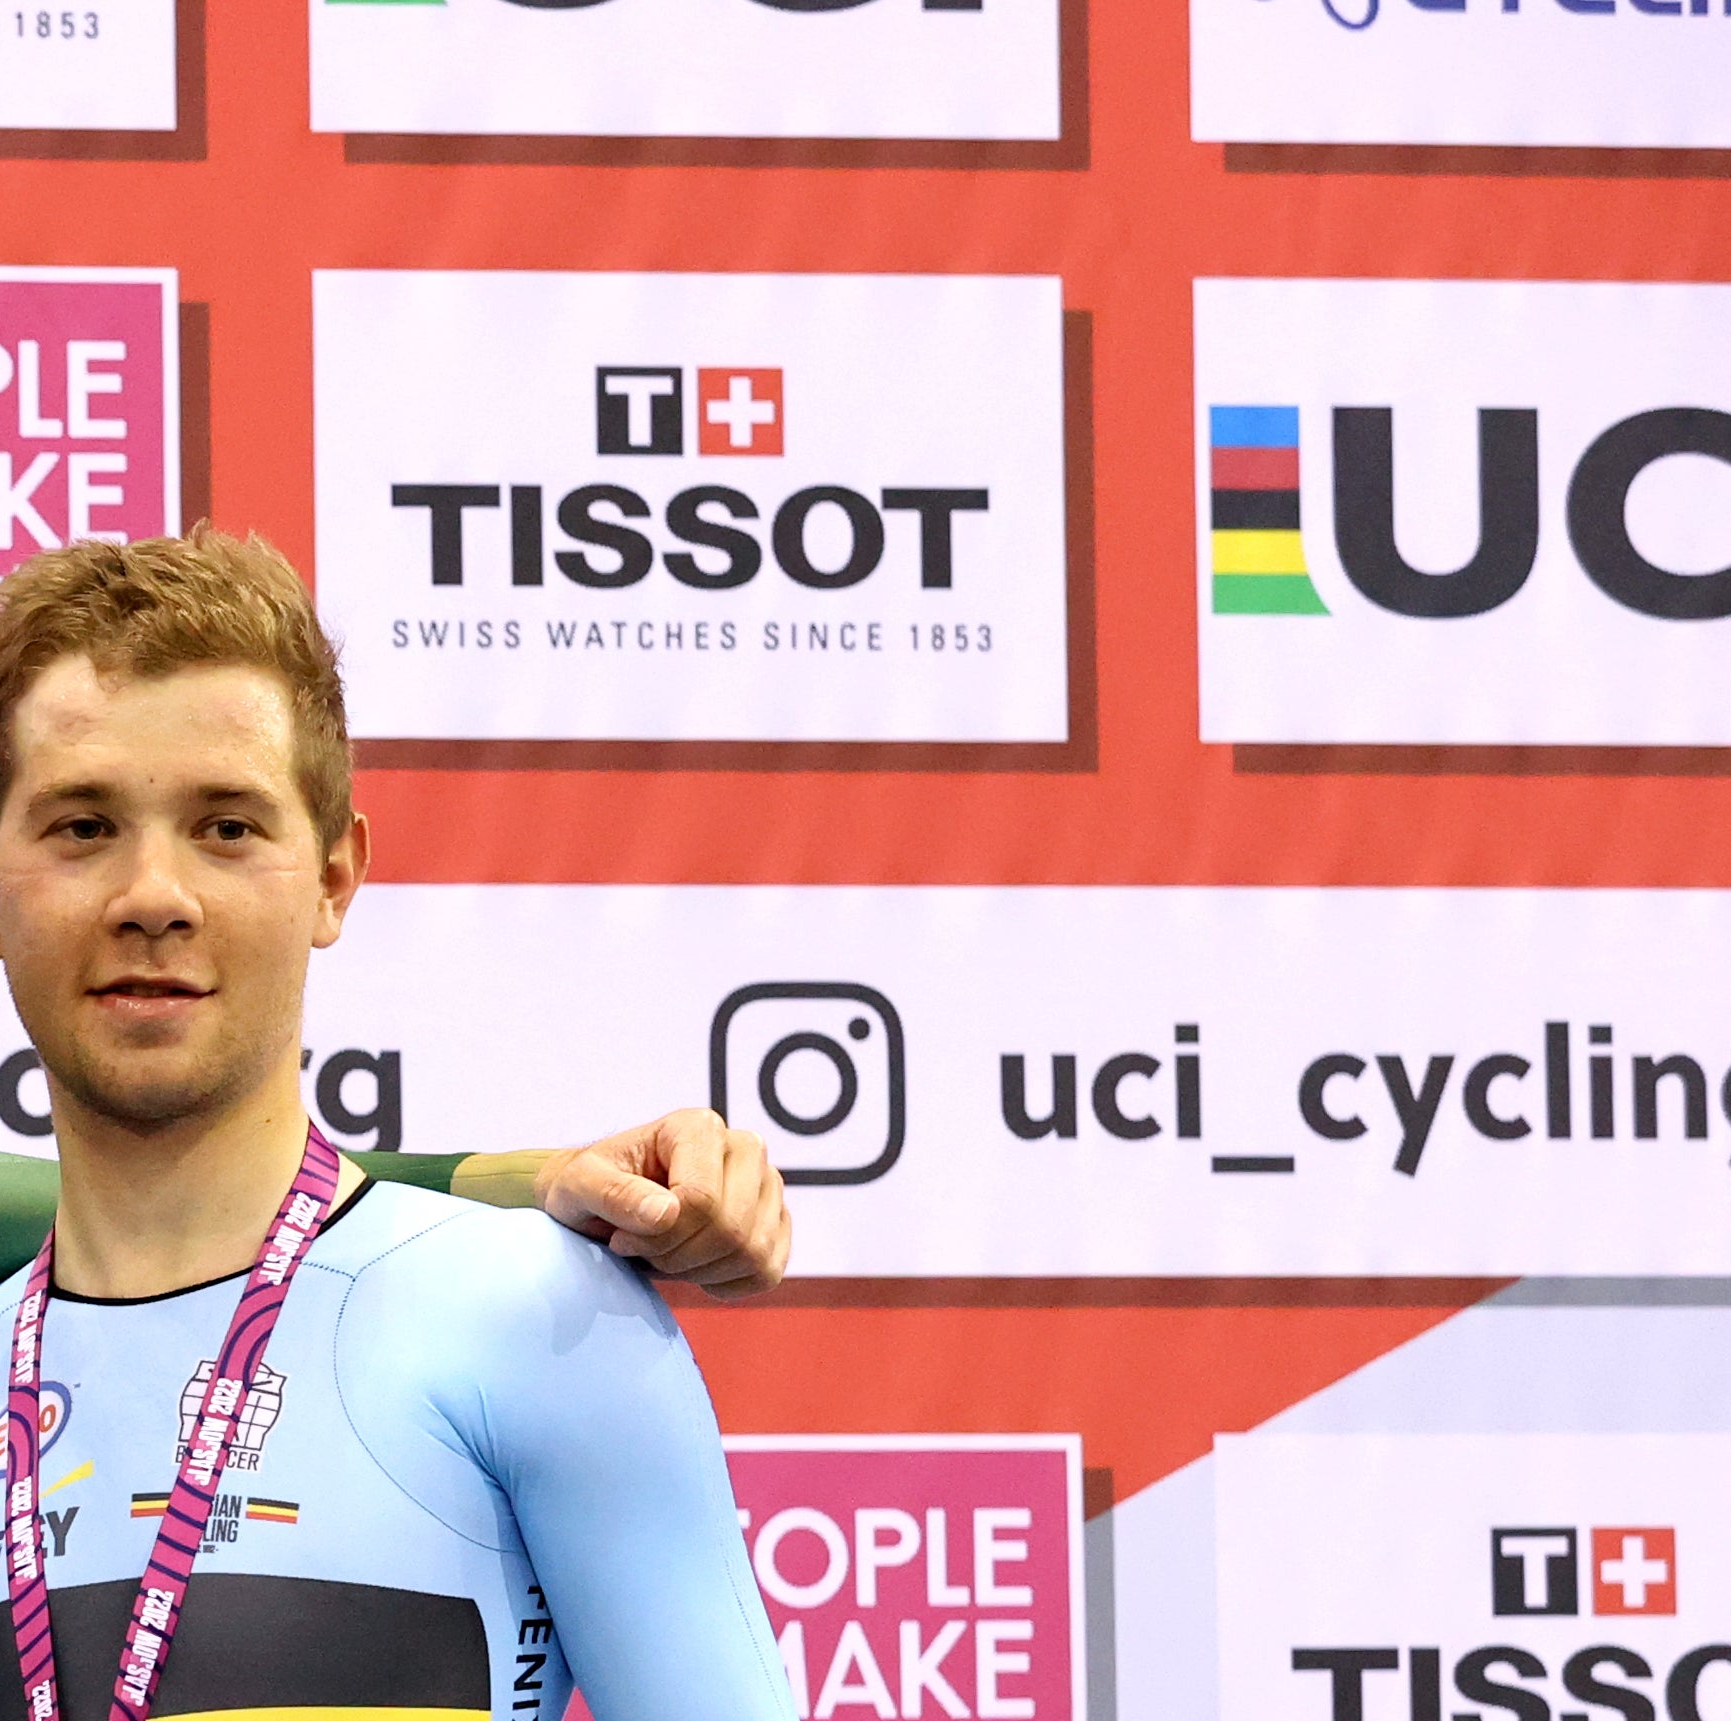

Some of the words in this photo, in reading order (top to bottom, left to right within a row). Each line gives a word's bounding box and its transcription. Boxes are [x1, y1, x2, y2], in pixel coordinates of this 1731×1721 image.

[14, 9, 101, 40] 1853
[390, 483, 990, 590] TISSOT
[391, 618, 523, 651] SWISS
[546, 619, 739, 652] WATCHES
[762, 621, 885, 653] SINCE
[909, 622, 995, 654] 1853
[1000, 1021, 1731, 1178] uci_cyclin
[736, 1506, 1033, 1609] OPLE
